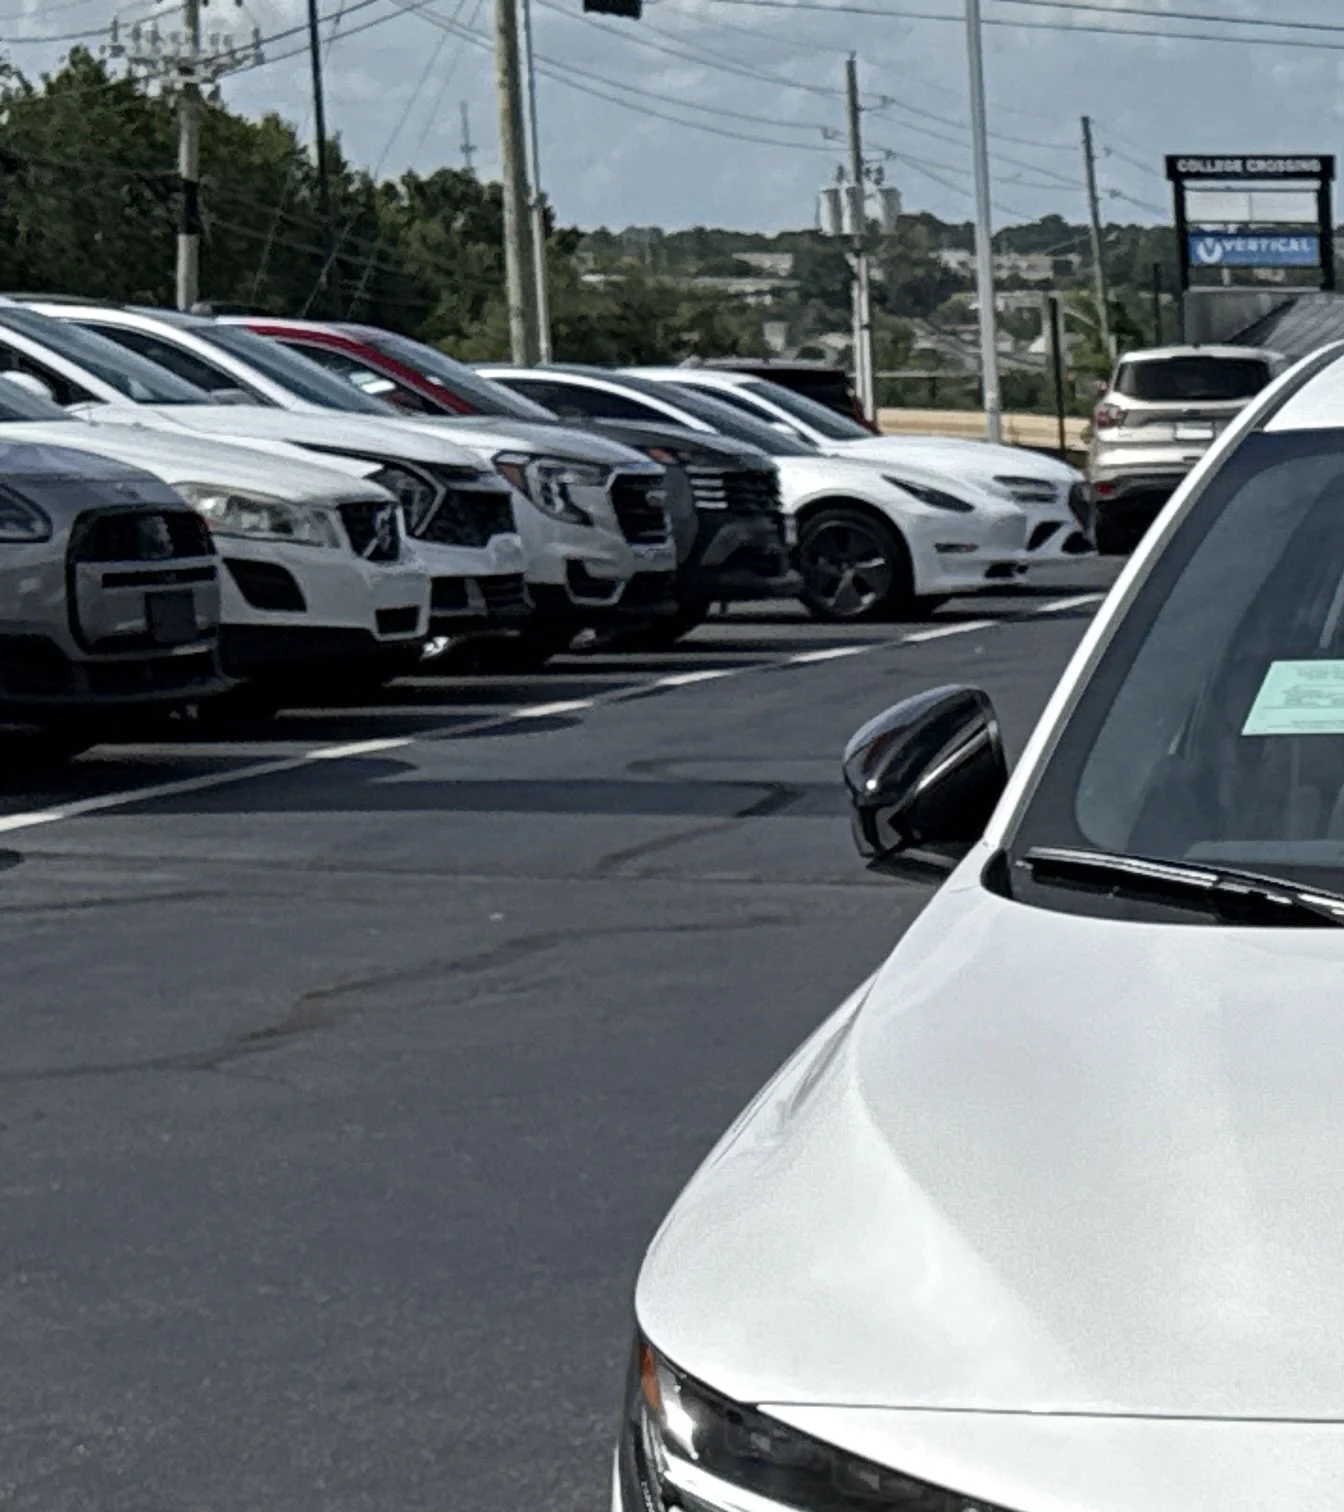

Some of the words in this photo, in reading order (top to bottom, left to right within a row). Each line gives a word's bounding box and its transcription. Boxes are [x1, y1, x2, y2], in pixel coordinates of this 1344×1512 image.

[1177, 159, 1242, 173] COLLEGE
[1246, 159, 1322, 173] CROSSING
[1223, 237, 1311, 253] VERTICAL
